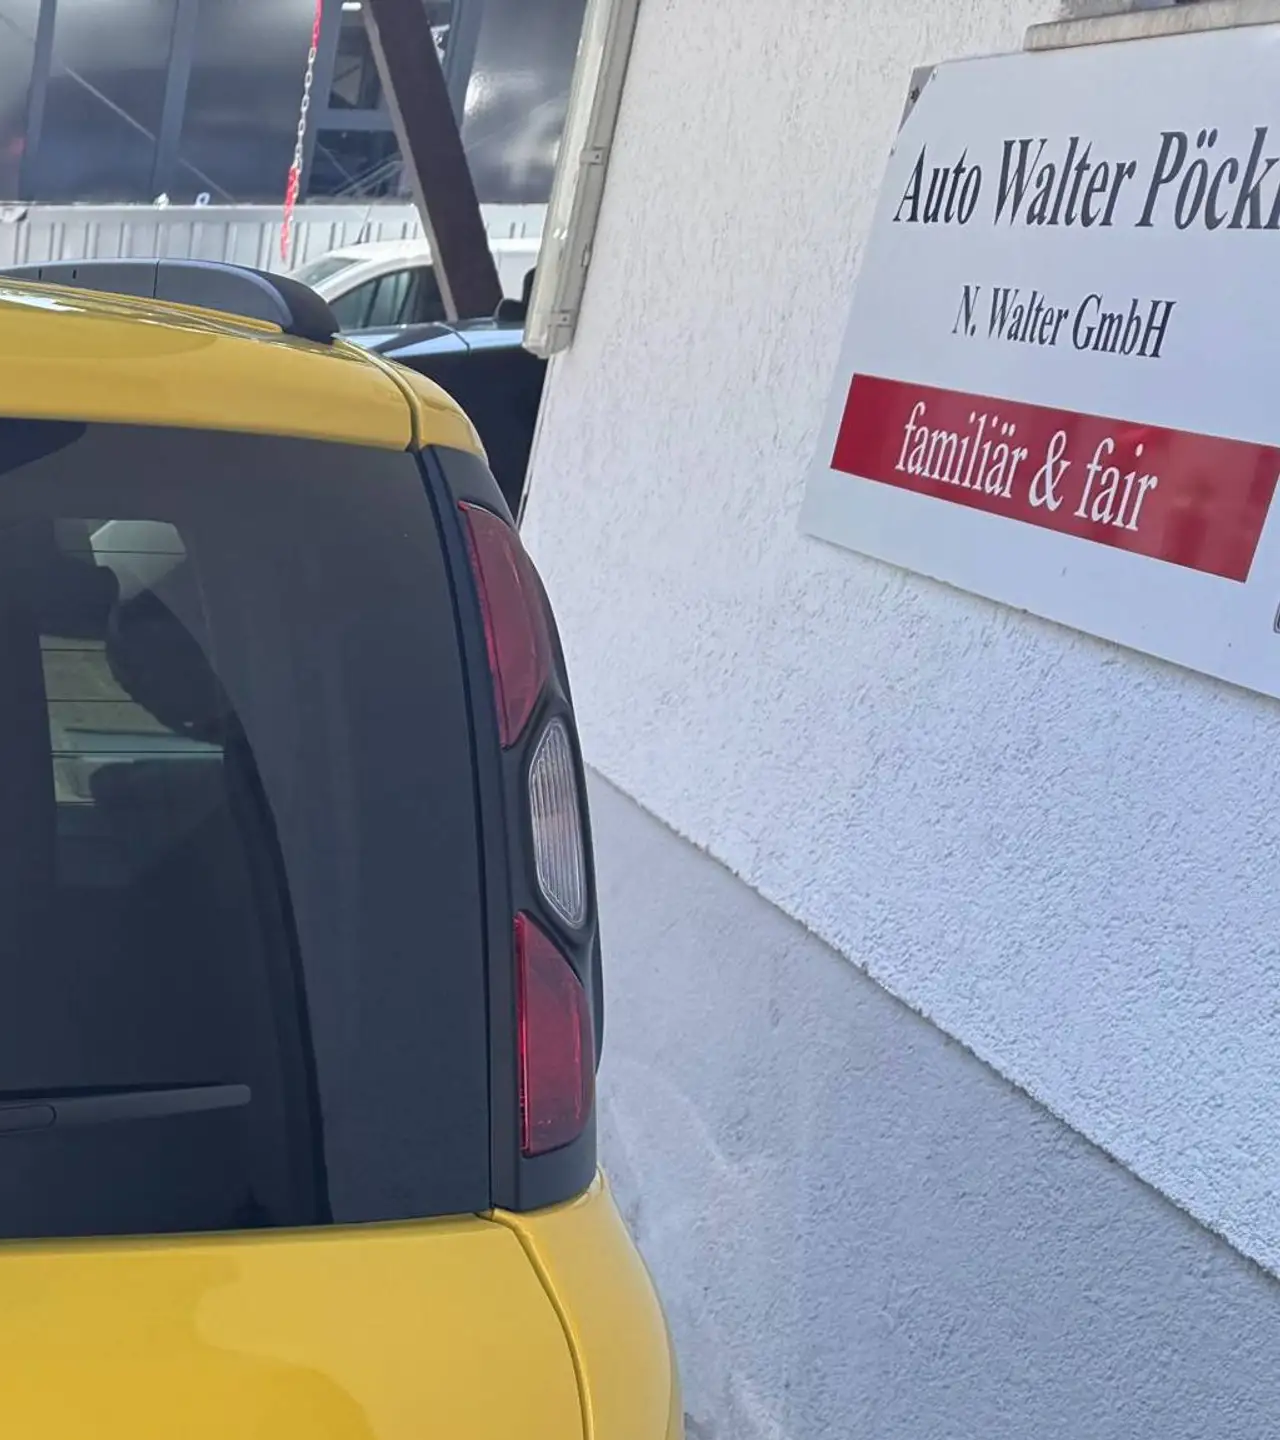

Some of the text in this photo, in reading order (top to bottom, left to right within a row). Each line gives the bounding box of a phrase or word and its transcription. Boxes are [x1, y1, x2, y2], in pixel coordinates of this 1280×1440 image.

[893, 143, 983, 226] Auto
[993, 135, 1138, 228] Walter
[951, 284, 1177, 359] N. Walter GmbH
[895, 400, 1159, 532] familiär & fair
